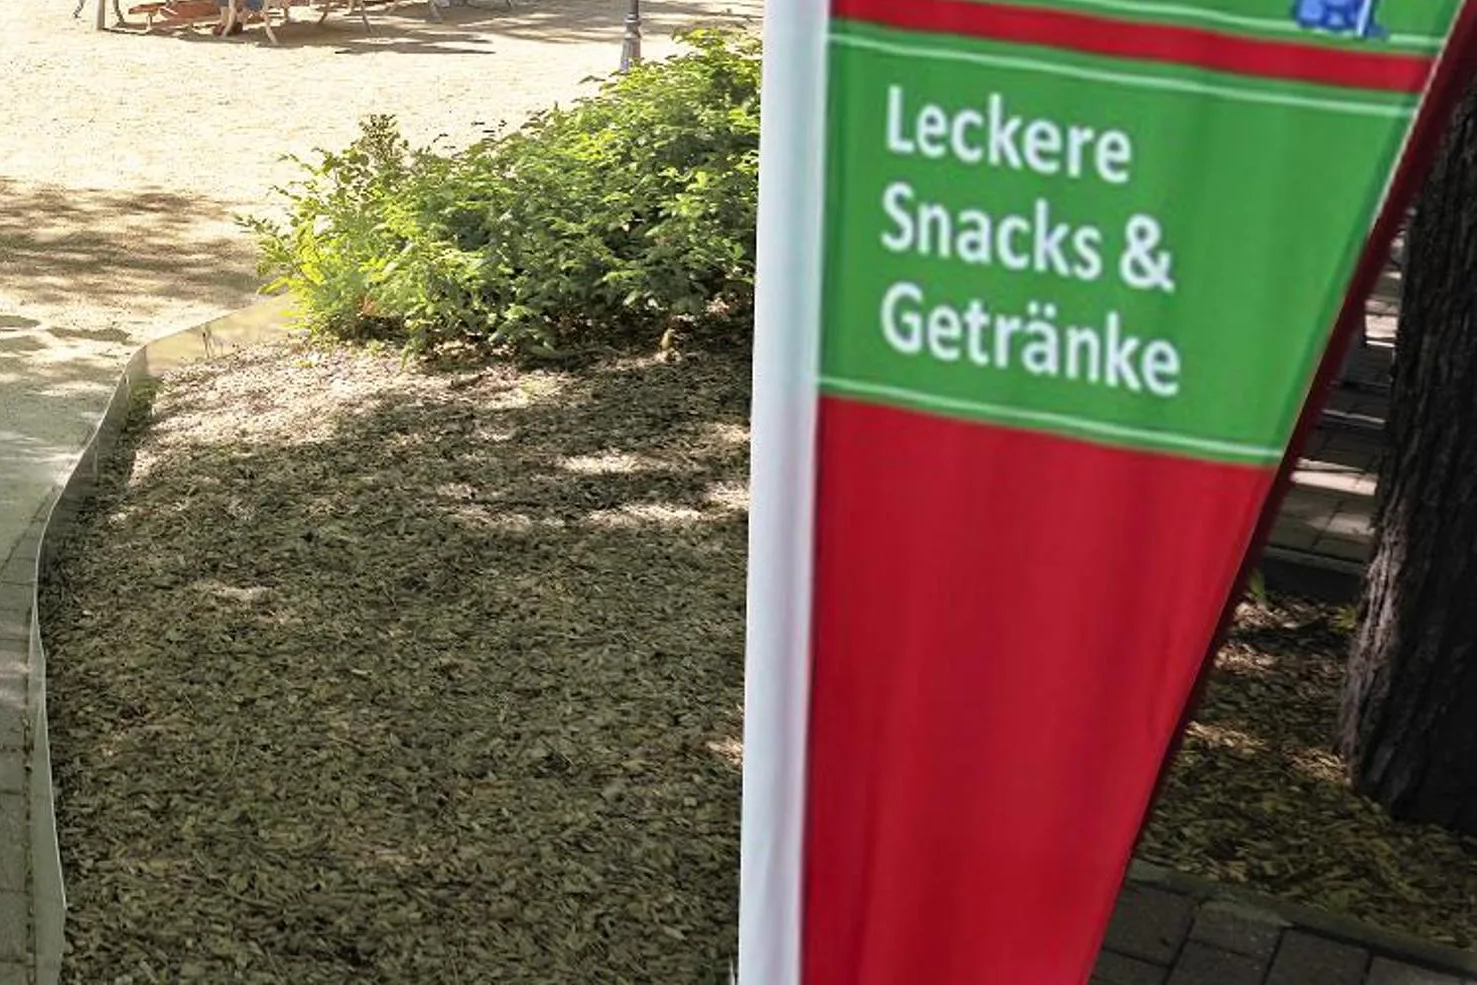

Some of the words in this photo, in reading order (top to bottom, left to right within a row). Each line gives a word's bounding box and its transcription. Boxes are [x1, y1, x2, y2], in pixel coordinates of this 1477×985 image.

[886, 84, 1132, 184] Leckere
[880, 181, 1104, 281] Snacks
[1119, 213, 1175, 293] &
[879, 281, 1181, 396] Getränke
